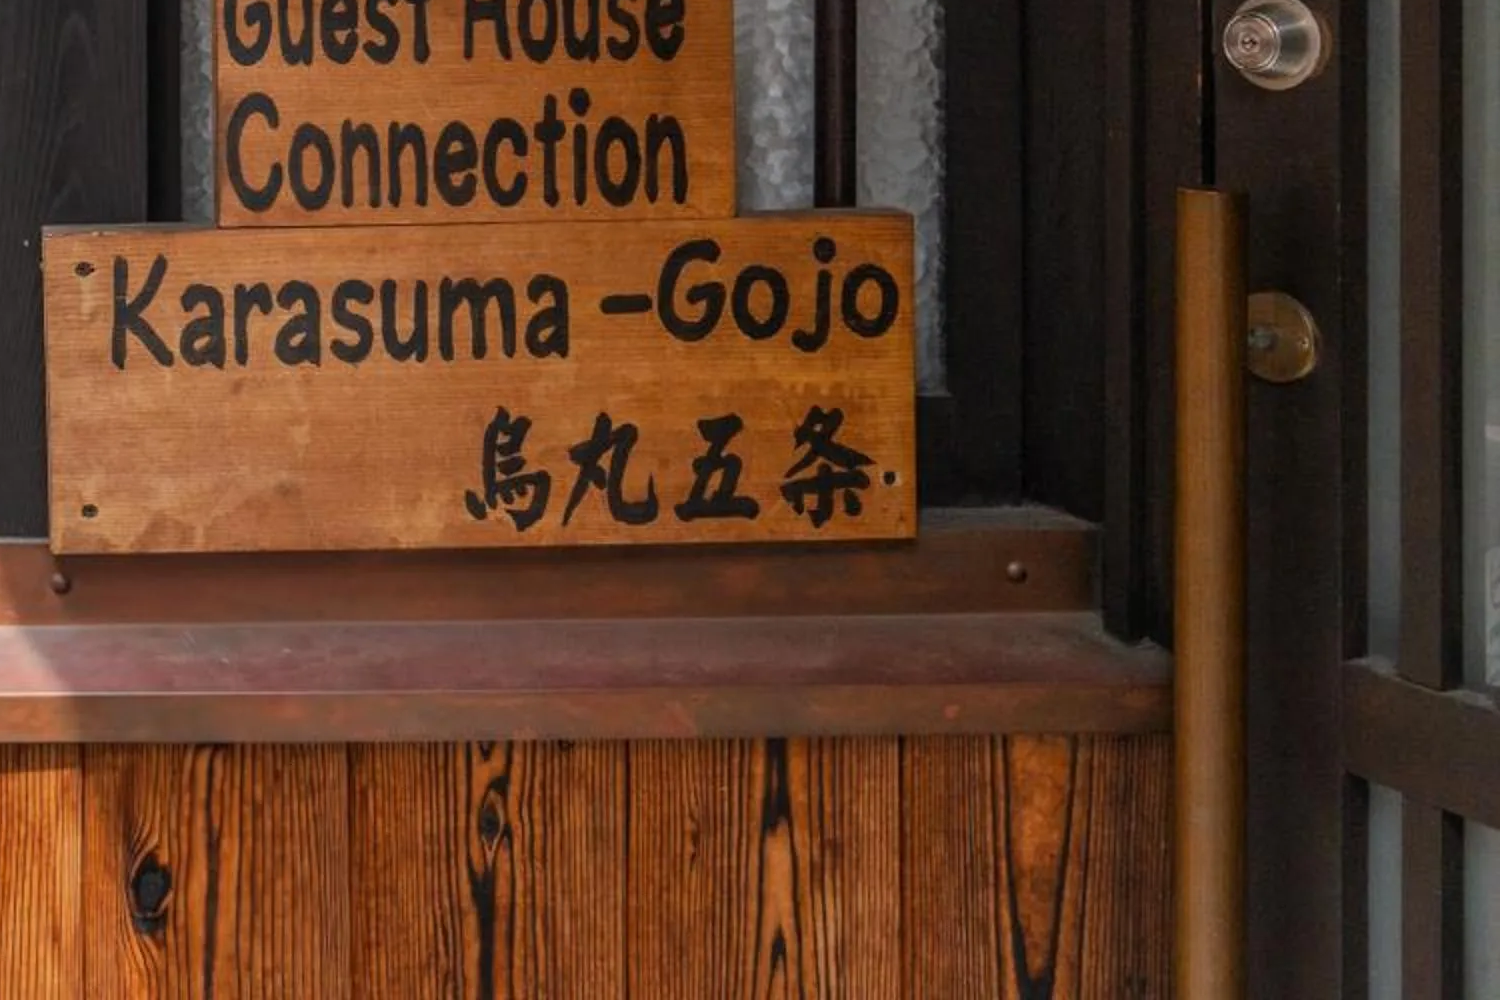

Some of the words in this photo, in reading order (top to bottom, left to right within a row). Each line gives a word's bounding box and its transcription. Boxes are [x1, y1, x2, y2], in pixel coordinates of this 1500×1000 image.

[225, 87, 689, 212] Connection
[111, 254, 571, 370] Karasuma
[464, 405, 876, 530] 烏丸五条
